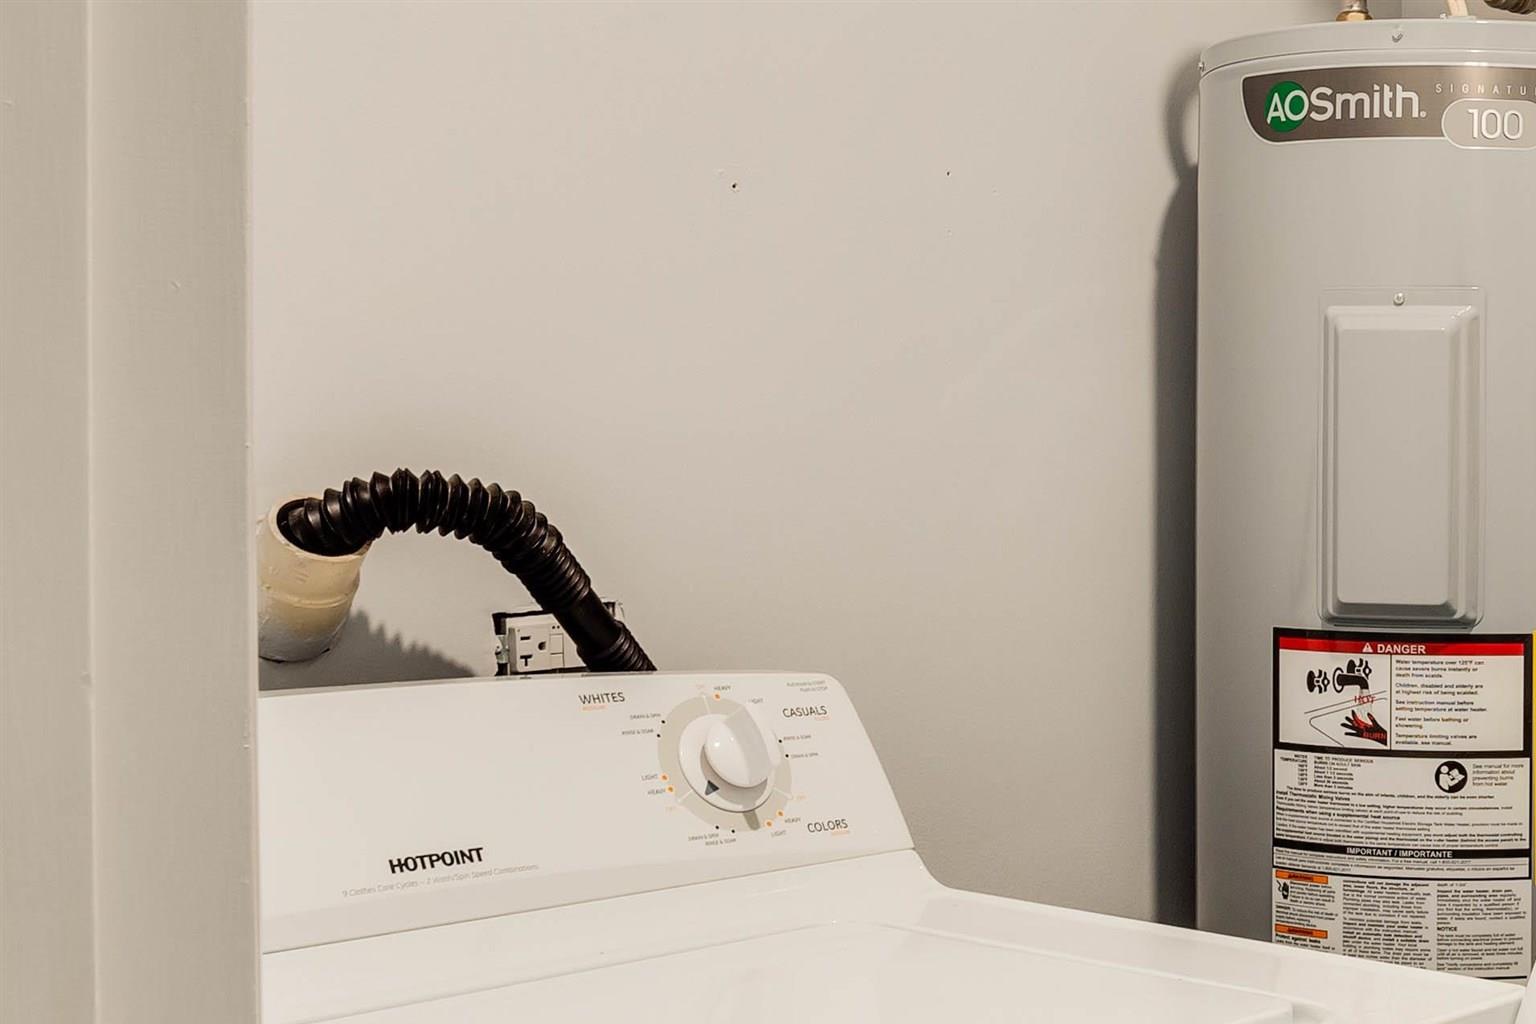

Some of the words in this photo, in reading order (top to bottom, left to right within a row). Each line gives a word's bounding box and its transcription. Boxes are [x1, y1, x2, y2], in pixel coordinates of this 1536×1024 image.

[1468, 109, 1523, 140] 100
[1377, 643, 1426, 654] DANGER
[579, 692, 625, 704] WHITES
[783, 706, 827, 717] CASUALS
[808, 819, 848, 832] COLORS
[1346, 847, 1393, 856] IMPORTANT
[1399, 850, 1453, 858] IMPORTANTE
[389, 848, 483, 874] HOTPOINT
